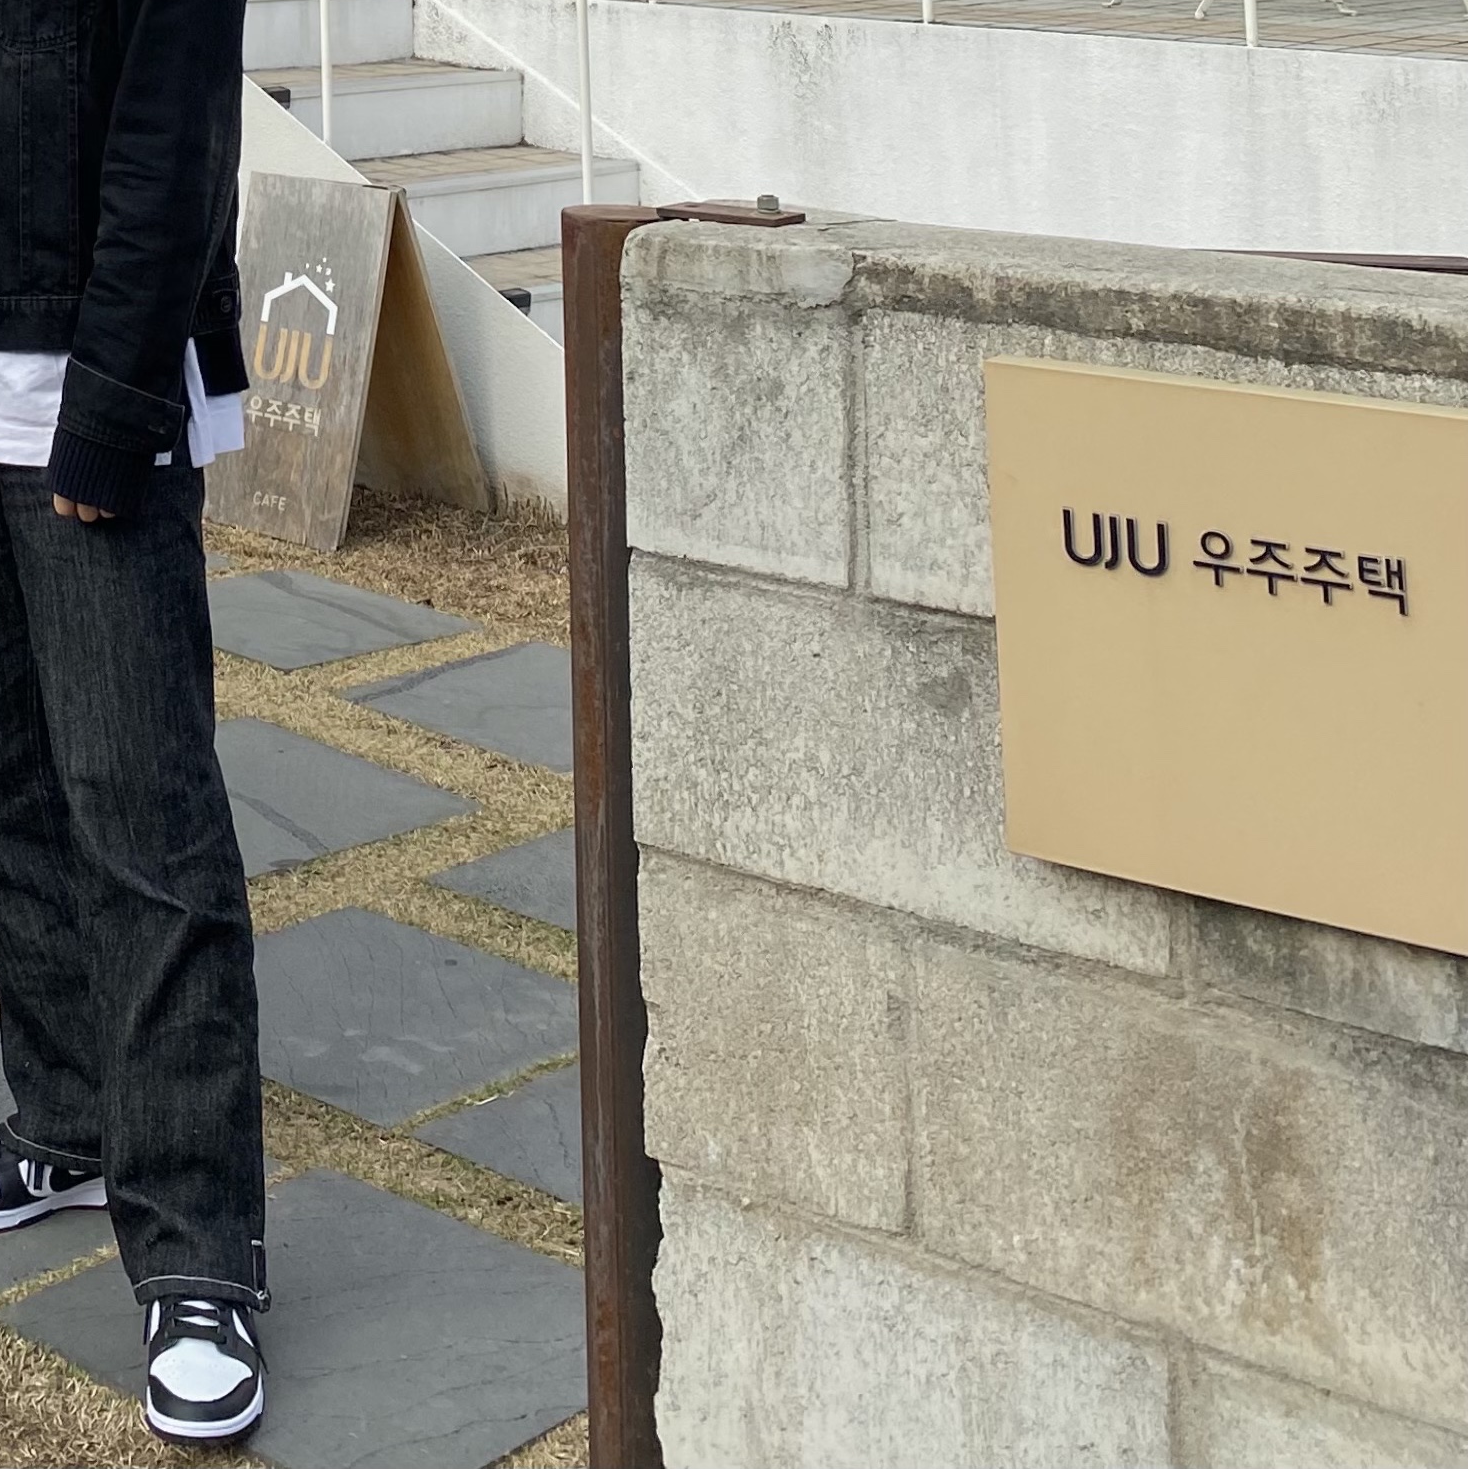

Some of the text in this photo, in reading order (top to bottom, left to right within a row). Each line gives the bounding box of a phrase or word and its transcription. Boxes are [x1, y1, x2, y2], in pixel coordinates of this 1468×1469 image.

[253, 322, 332, 390] UJU
[246, 395, 322, 438] 우주주택
[252, 490, 287, 512] CAFE
[1062, 507, 1410, 617] UJU 우주주택
